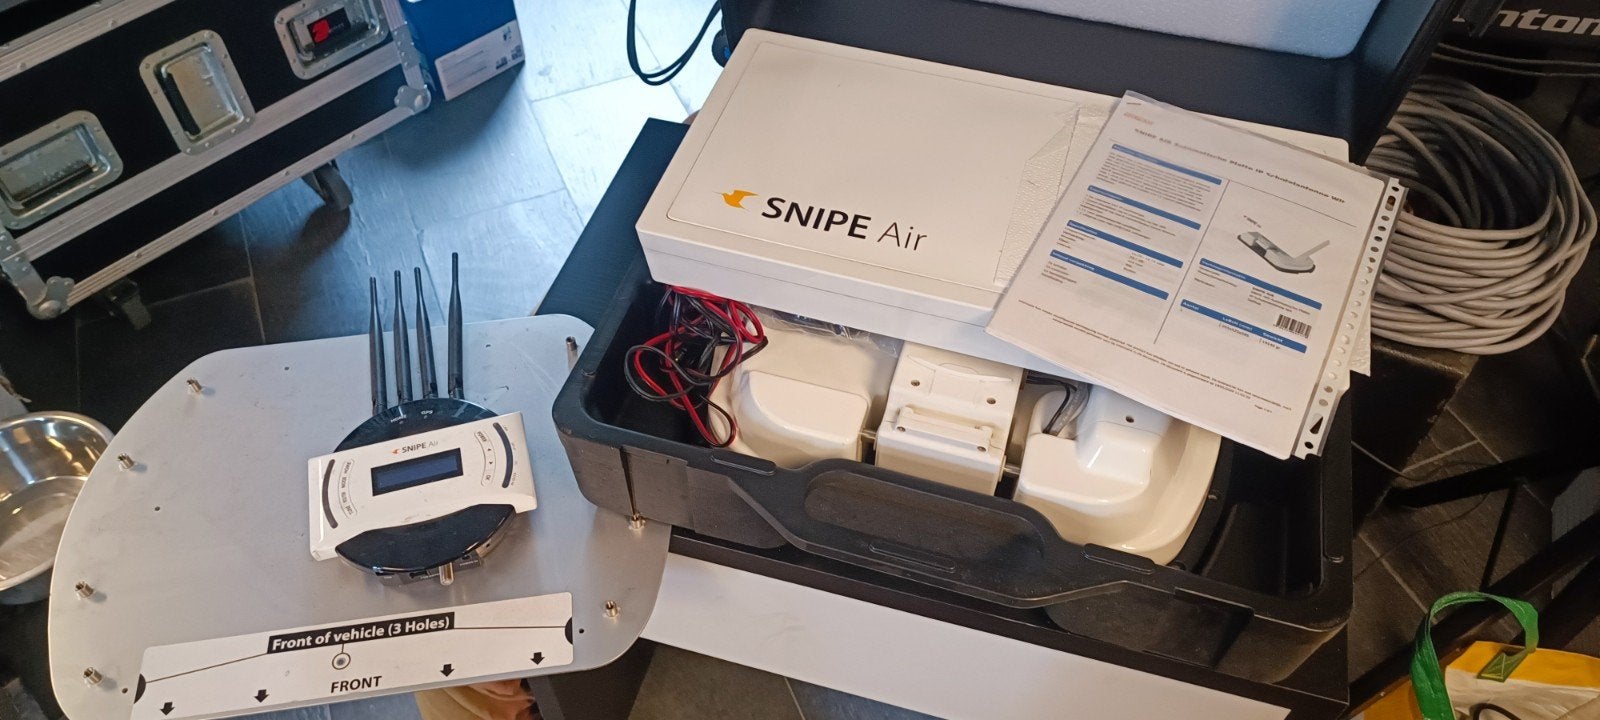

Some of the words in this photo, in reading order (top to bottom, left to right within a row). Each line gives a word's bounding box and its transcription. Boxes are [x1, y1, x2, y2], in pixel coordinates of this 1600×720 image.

[762, 197, 871, 240] SNIPE
[877, 221, 927, 251] Air
[402, 442, 426, 453] SNIPE
[272, 634, 313, 652] Front
[316, 631, 333, 646] of
[334, 625, 385, 643] vehicle
[387, 622, 402, 638] (3
[404, 616, 450, 634] Holes)
[330, 675, 383, 693] FRONT
